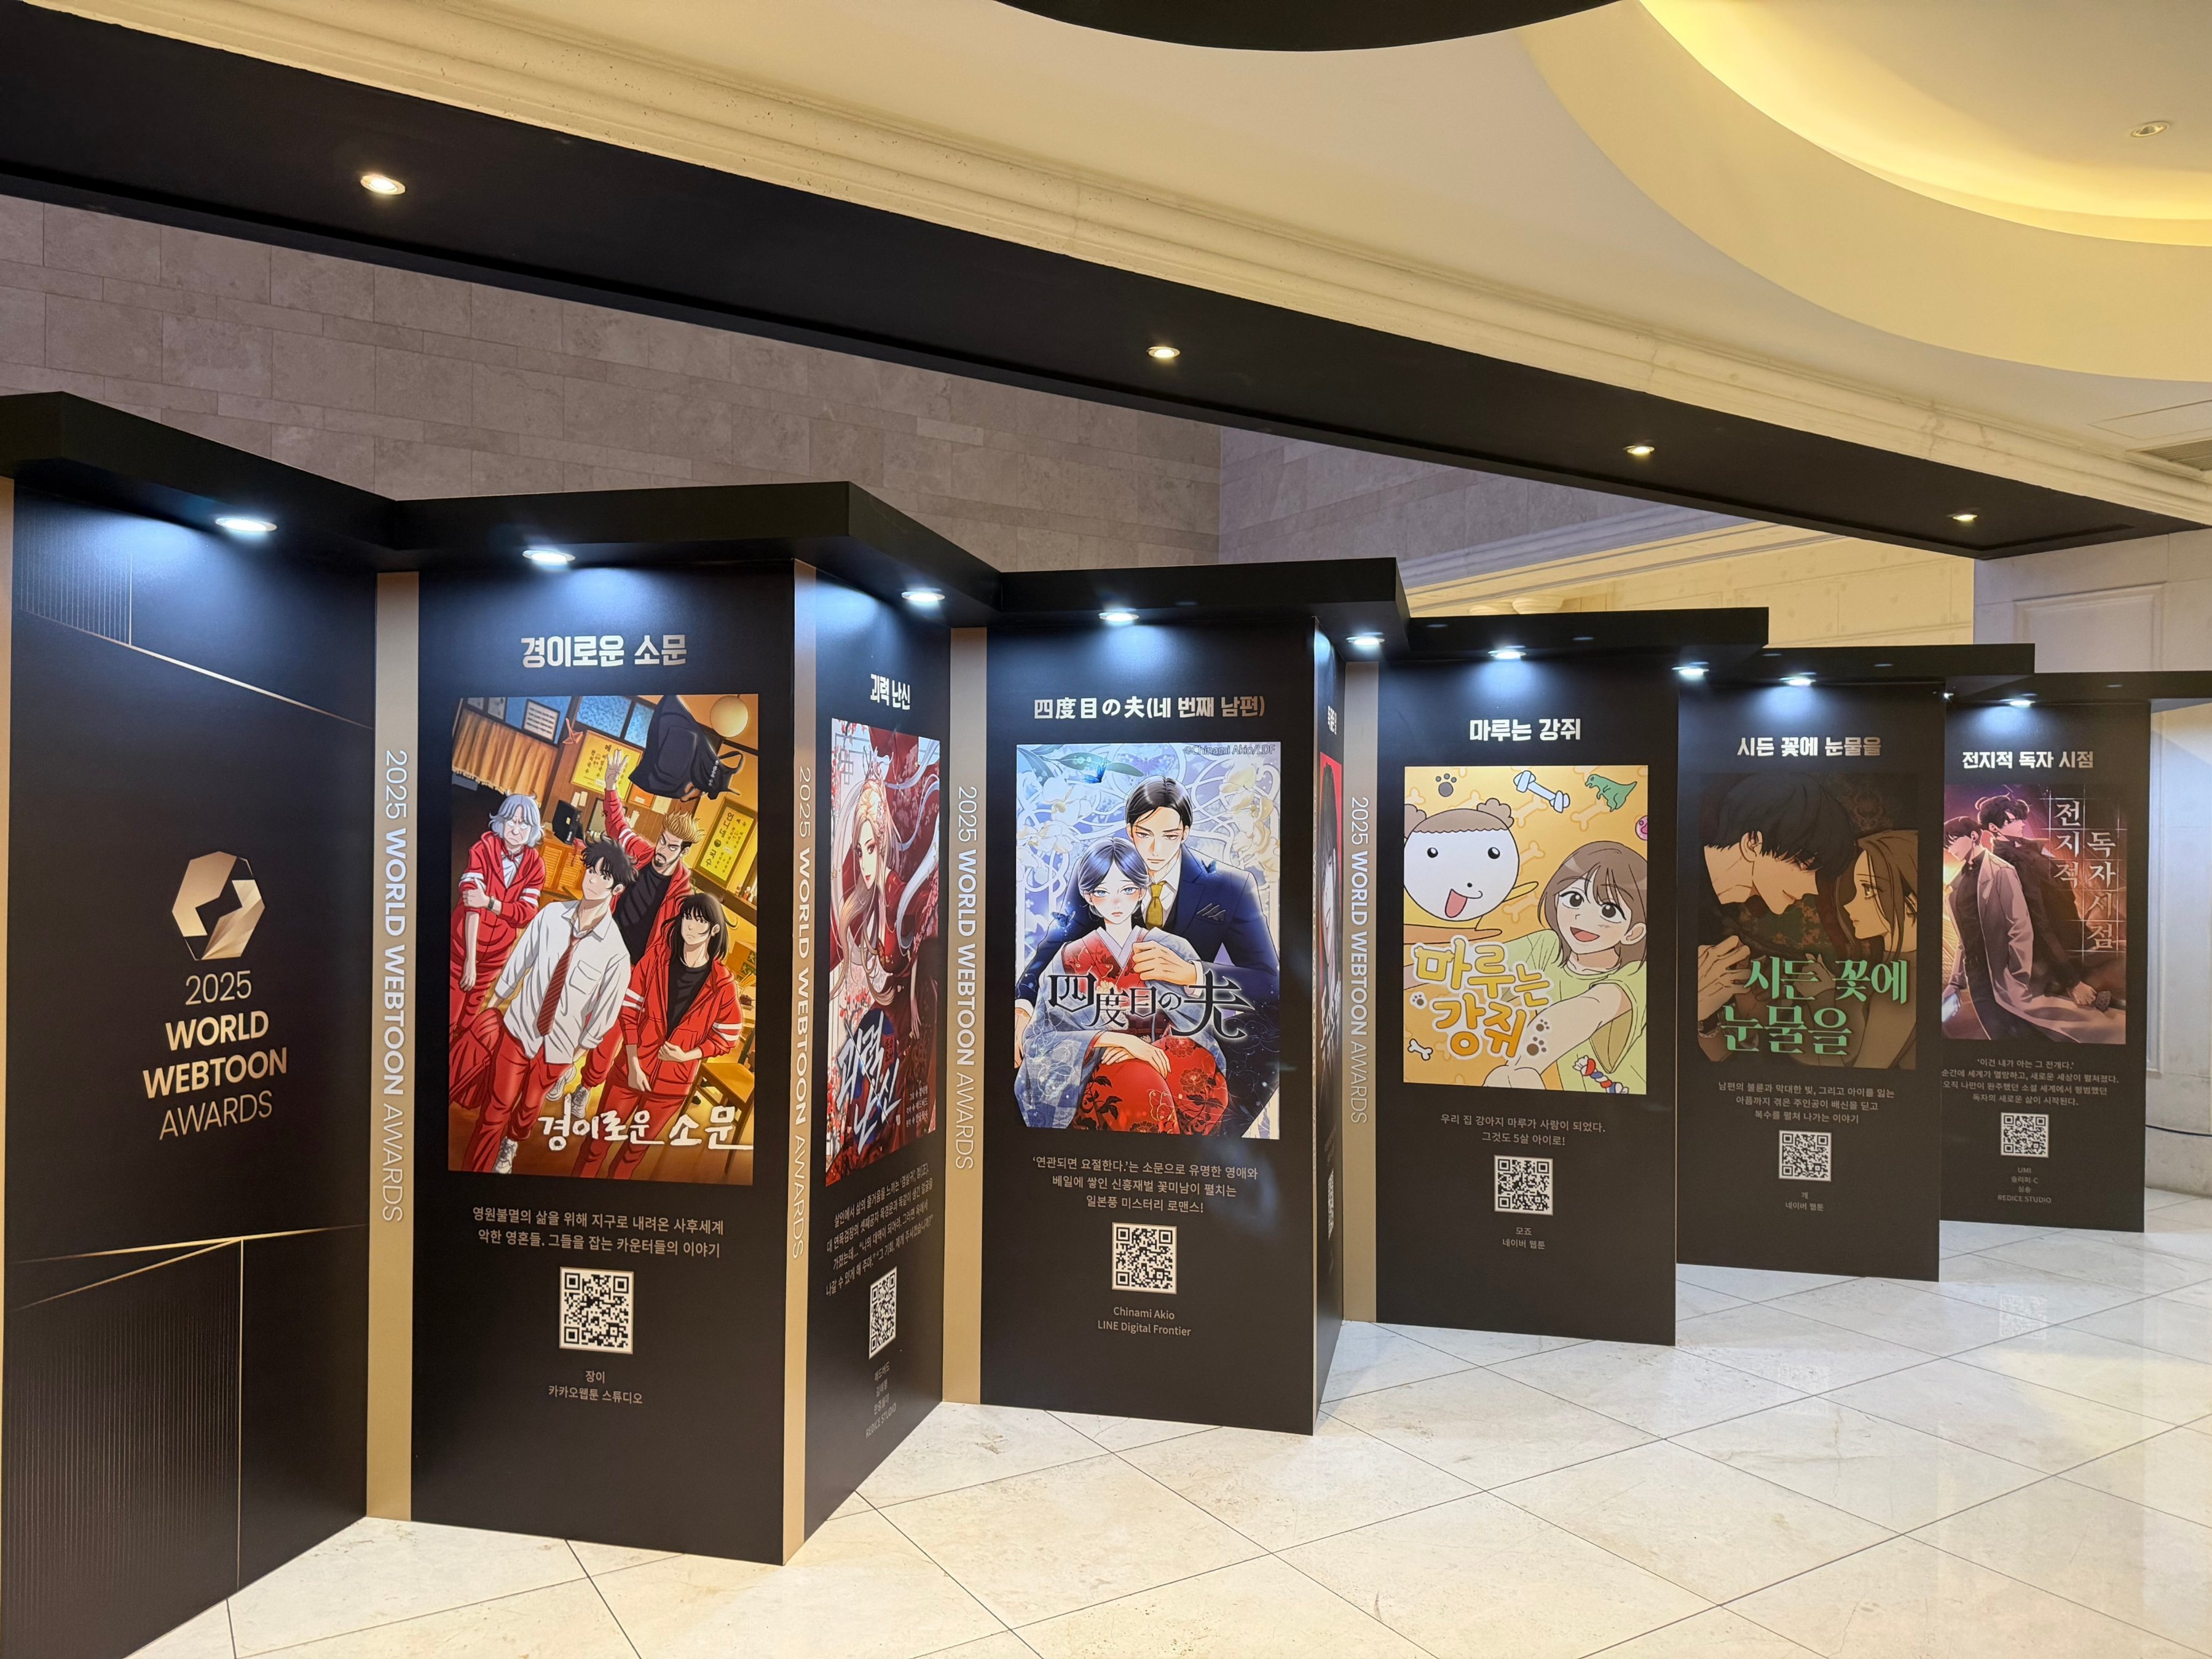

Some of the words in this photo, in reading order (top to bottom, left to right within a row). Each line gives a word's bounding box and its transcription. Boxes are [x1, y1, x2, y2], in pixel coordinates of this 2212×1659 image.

[521, 634, 624, 668] 경이로운
[634, 634, 687, 666] 소문
[870, 674, 889, 706] 괴력
[892, 680, 910, 710] 난신
[1034, 695, 1171, 720] 四度目の夫(네
[1178, 696, 1214, 719] 번째
[1221, 695, 1265, 718] 남편)
[1470, 719, 1532, 742] 마루는
[1539, 718, 1581, 740] 강쥐
[1737, 736, 1774, 757] 시든
[1781, 736, 1818, 757] 꽃에
[1825, 736, 1881, 757] 눈물을
[1232, 744, 1276, 755] Akio/LDF
[1962, 751, 2013, 770] 전지적
[2019, 751, 2054, 768] 독자
[2058, 751, 2093, 768] 시점
[386, 750, 407, 819] 2025
[800, 766, 811, 837] 2025
[958, 786, 977, 842] 2025
[1352, 797, 1369, 845] 2025
[2053, 800, 2080, 888] 전지적
[385, 828, 406, 936] WORLD
[958, 849, 977, 937] WORLD
[1352, 851, 1368, 926] WORLD
[799, 847, 810, 958] WORLD
[185, 970, 252, 1006] 2025
[1351, 931, 1368, 1035] WEBTOON
[1414, 938, 1550, 1007] 마루는
[1743, 956, 1819, 1001] 시든
[1832, 959, 1908, 1004] 꽃에
[384, 944, 406, 1095] WEBTOON
[957, 944, 975, 1065] WEBTOON
[1047, 968, 1256, 1039] 四度目の夫
[165, 1011, 269, 1051] WORLD
[1433, 993, 1527, 1057] 강쥐
[1721, 1004, 1852, 1055] 눈물을
[796, 967, 809, 1125] WEBTOON
[1998, 1059, 2013, 1068] 내가
[2017, 1060, 2033, 1068] 아는
[143, 1047, 288, 1099] WEBTOON
[1351, 1041, 1367, 1123] AWARDS
[1718, 1082, 1744, 1092] 남편의
[1747, 1083, 1773, 1093] 불륜과
[1776, 1084, 1802, 1094] 막대한
[1805, 1086, 1816, 1096] 빚,
[1819, 1086, 1844, 1096] 그리고
[1848, 1087, 1873, 1097] 아이를
[1877, 1088, 1895, 1098] 잃는
[1994, 1071, 2028, 1080] 멸망하고,
[2031, 1072, 2053, 1081] 새로운
[2057, 1073, 2080, 1082] 세상이
[2041, 1085, 2072, 1094] 세계에서
[159, 1090, 273, 1140] AWARDS
[1736, 1095, 1770, 1106] 아픔까지
[1773, 1097, 1791, 1107] 겪은
[1793, 1098, 1828, 1109] 주인공이
[1831, 1100, 1857, 1110] 배신을
[1861, 1101, 1878, 1111] 딛고
[1755, 1109, 1780, 1120] 복수를
[1784, 1111, 1800, 1121] 펼쳐
[1803, 1112, 1830, 1122] 나가는
[1833, 1113, 1859, 1124] 이야기
[1972, 1094, 1996, 1102] 독자의
[1999, 1095, 2022, 1103] 새로운
[2044, 1097, 2078, 1106] 시작된다.
[538, 1093, 665, 1151] 경이로운
[670, 1106, 754, 1151] 소문
[956, 1072, 974, 1169] AWARDS
[1441, 1114, 1460, 1125] 우리
[1463, 1116, 1472, 1125] 집
[1476, 1116, 1504, 1127] 강아지
[1508, 1117, 1537, 1129] 마루가
[1540, 1119, 1569, 1131] 사람이
[1573, 1122, 1605, 1133] 되었다.
[1482, 1132, 1511, 1143] 그것도
[1513, 1134, 1529, 1144] 5살
[1532, 1135, 1565, 1146] 아이로!
[382, 1103, 403, 1222] AWARDS
[1143, 1162, 1186, 1176] 소문으로
[1189, 1164, 1222, 1178] 유명한
[1225, 1165, 1258, 1180] 영애와
[793, 1135, 805, 1258] AWARDS
[834, 1204, 854, 1228] 살인에서
[856, 1197, 866, 1215] 삶의
[867, 1187, 885, 1208] 즐거움을
[887, 1180, 899, 1196] 느끼는
[1052, 1175, 1084, 1189] 베일에
[1087, 1177, 1108, 1191] 쌓인
[1111, 1179, 1154, 1193] 신흥재벌
[1157, 1181, 1200, 1196] 꽃미남이
[1204, 1183, 1237, 1197] 펼치는
[1087, 1195, 1118, 1208] 일본풍
[1121, 1197, 1163, 1212] 미스터리
[1167, 1199, 1203, 1213] 로맨스!
[473, 1207, 531, 1224] 영원불멸의
[536, 1210, 559, 1226] 삶을
[564, 1212, 588, 1228] 위해
[592, 1213, 628, 1229] 지구로
[633, 1215, 669, 1232] 내려온
[674, 1218, 724, 1235] 사후세계
[827, 1239, 832, 1252] 대
[912, 1186, 920, 1200] 생긴
[1785, 1201, 1807, 1210] 네이버
[478, 1229, 502, 1245] 악한
[506, 1231, 545, 1247] 영혼들.
[548, 1234, 584, 1250] 그들을
[588, 1235, 613, 1251] 잡는
[616, 1237, 679, 1256] 카운터들의
[683, 1241, 720, 1258] 이야기
[873, 1226, 886, 1244] 대역이
[902, 1208, 915, 1225] 그러면
[1516, 1227, 1532, 1235] 모죠
[1502, 1239, 1527, 1248] 네이버
[1529, 1240, 1545, 1250] 웹툰
[826, 1279, 836, 1296] 나갈
[838, 1274, 843, 1289] 수
[844, 1266, 855, 1285] 있게
[1098, 1320, 1119, 1331] LINE
[1120, 1322, 1151, 1334] Digital
[1153, 1323, 1192, 1337] Frontier
[1113, 1306, 1152, 1318] Chinami
[1154, 1309, 1175, 1320] Akio
[548, 1385, 598, 1401] 카카오웹툰
[602, 1388, 643, 1405] 스튜디오
[585, 1371, 605, 1384] 장이
